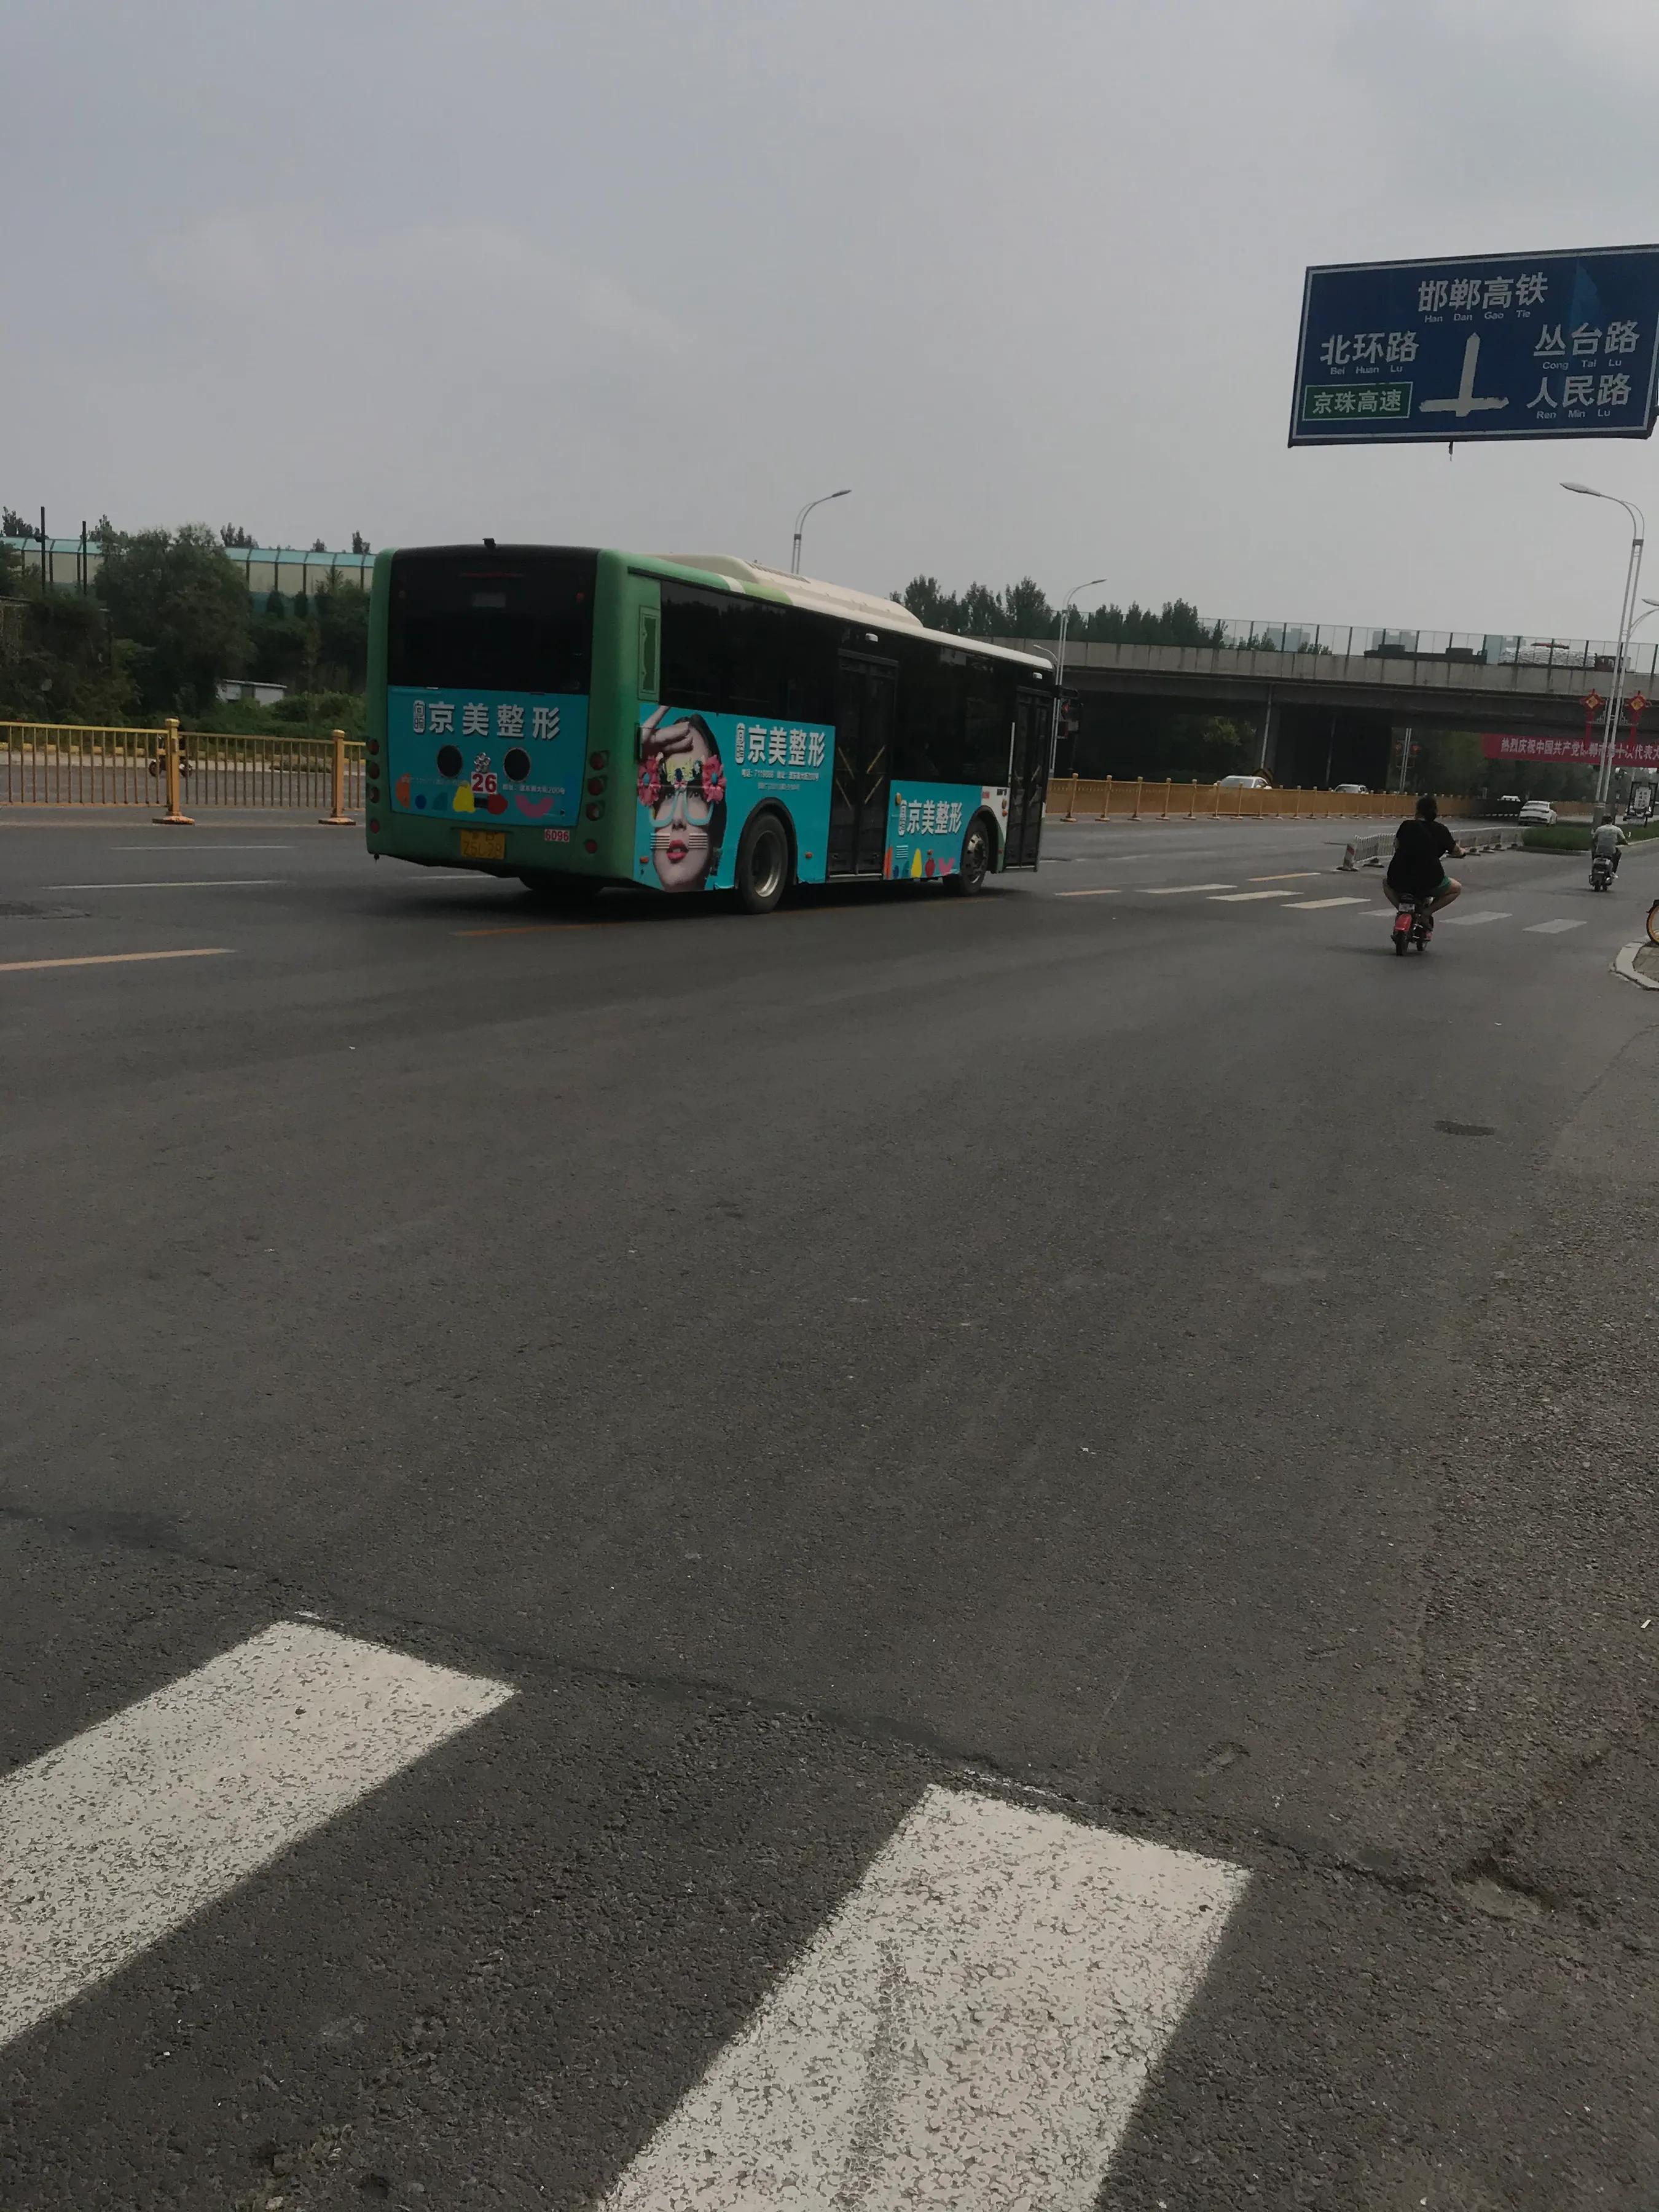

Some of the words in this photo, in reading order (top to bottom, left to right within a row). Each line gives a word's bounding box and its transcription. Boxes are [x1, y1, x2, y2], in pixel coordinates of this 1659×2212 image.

[1418, 272, 1548, 312] 邯郸高铁
[1320, 331, 1419, 365] 北环路
[1533, 320, 1640, 356] 丛台路
[1355, 366, 1379, 374] Huan
[1542, 361, 1569, 371] Cong
[1582, 359, 1596, 368] Tai
[1312, 389, 1402, 414] 京珠高速
[1526, 373, 1632, 409] 人民路
[1536, 410, 1556, 419] Ren
[1568, 409, 1585, 418] Min
[1598, 408, 1611, 417] Lu
[428, 701, 560, 739] 京美整形
[747, 724, 825, 767] 京美整形
[472, 774, 496, 793] 26
[906, 799, 962, 834] 京美整形
[545, 830, 569, 841] 6096
